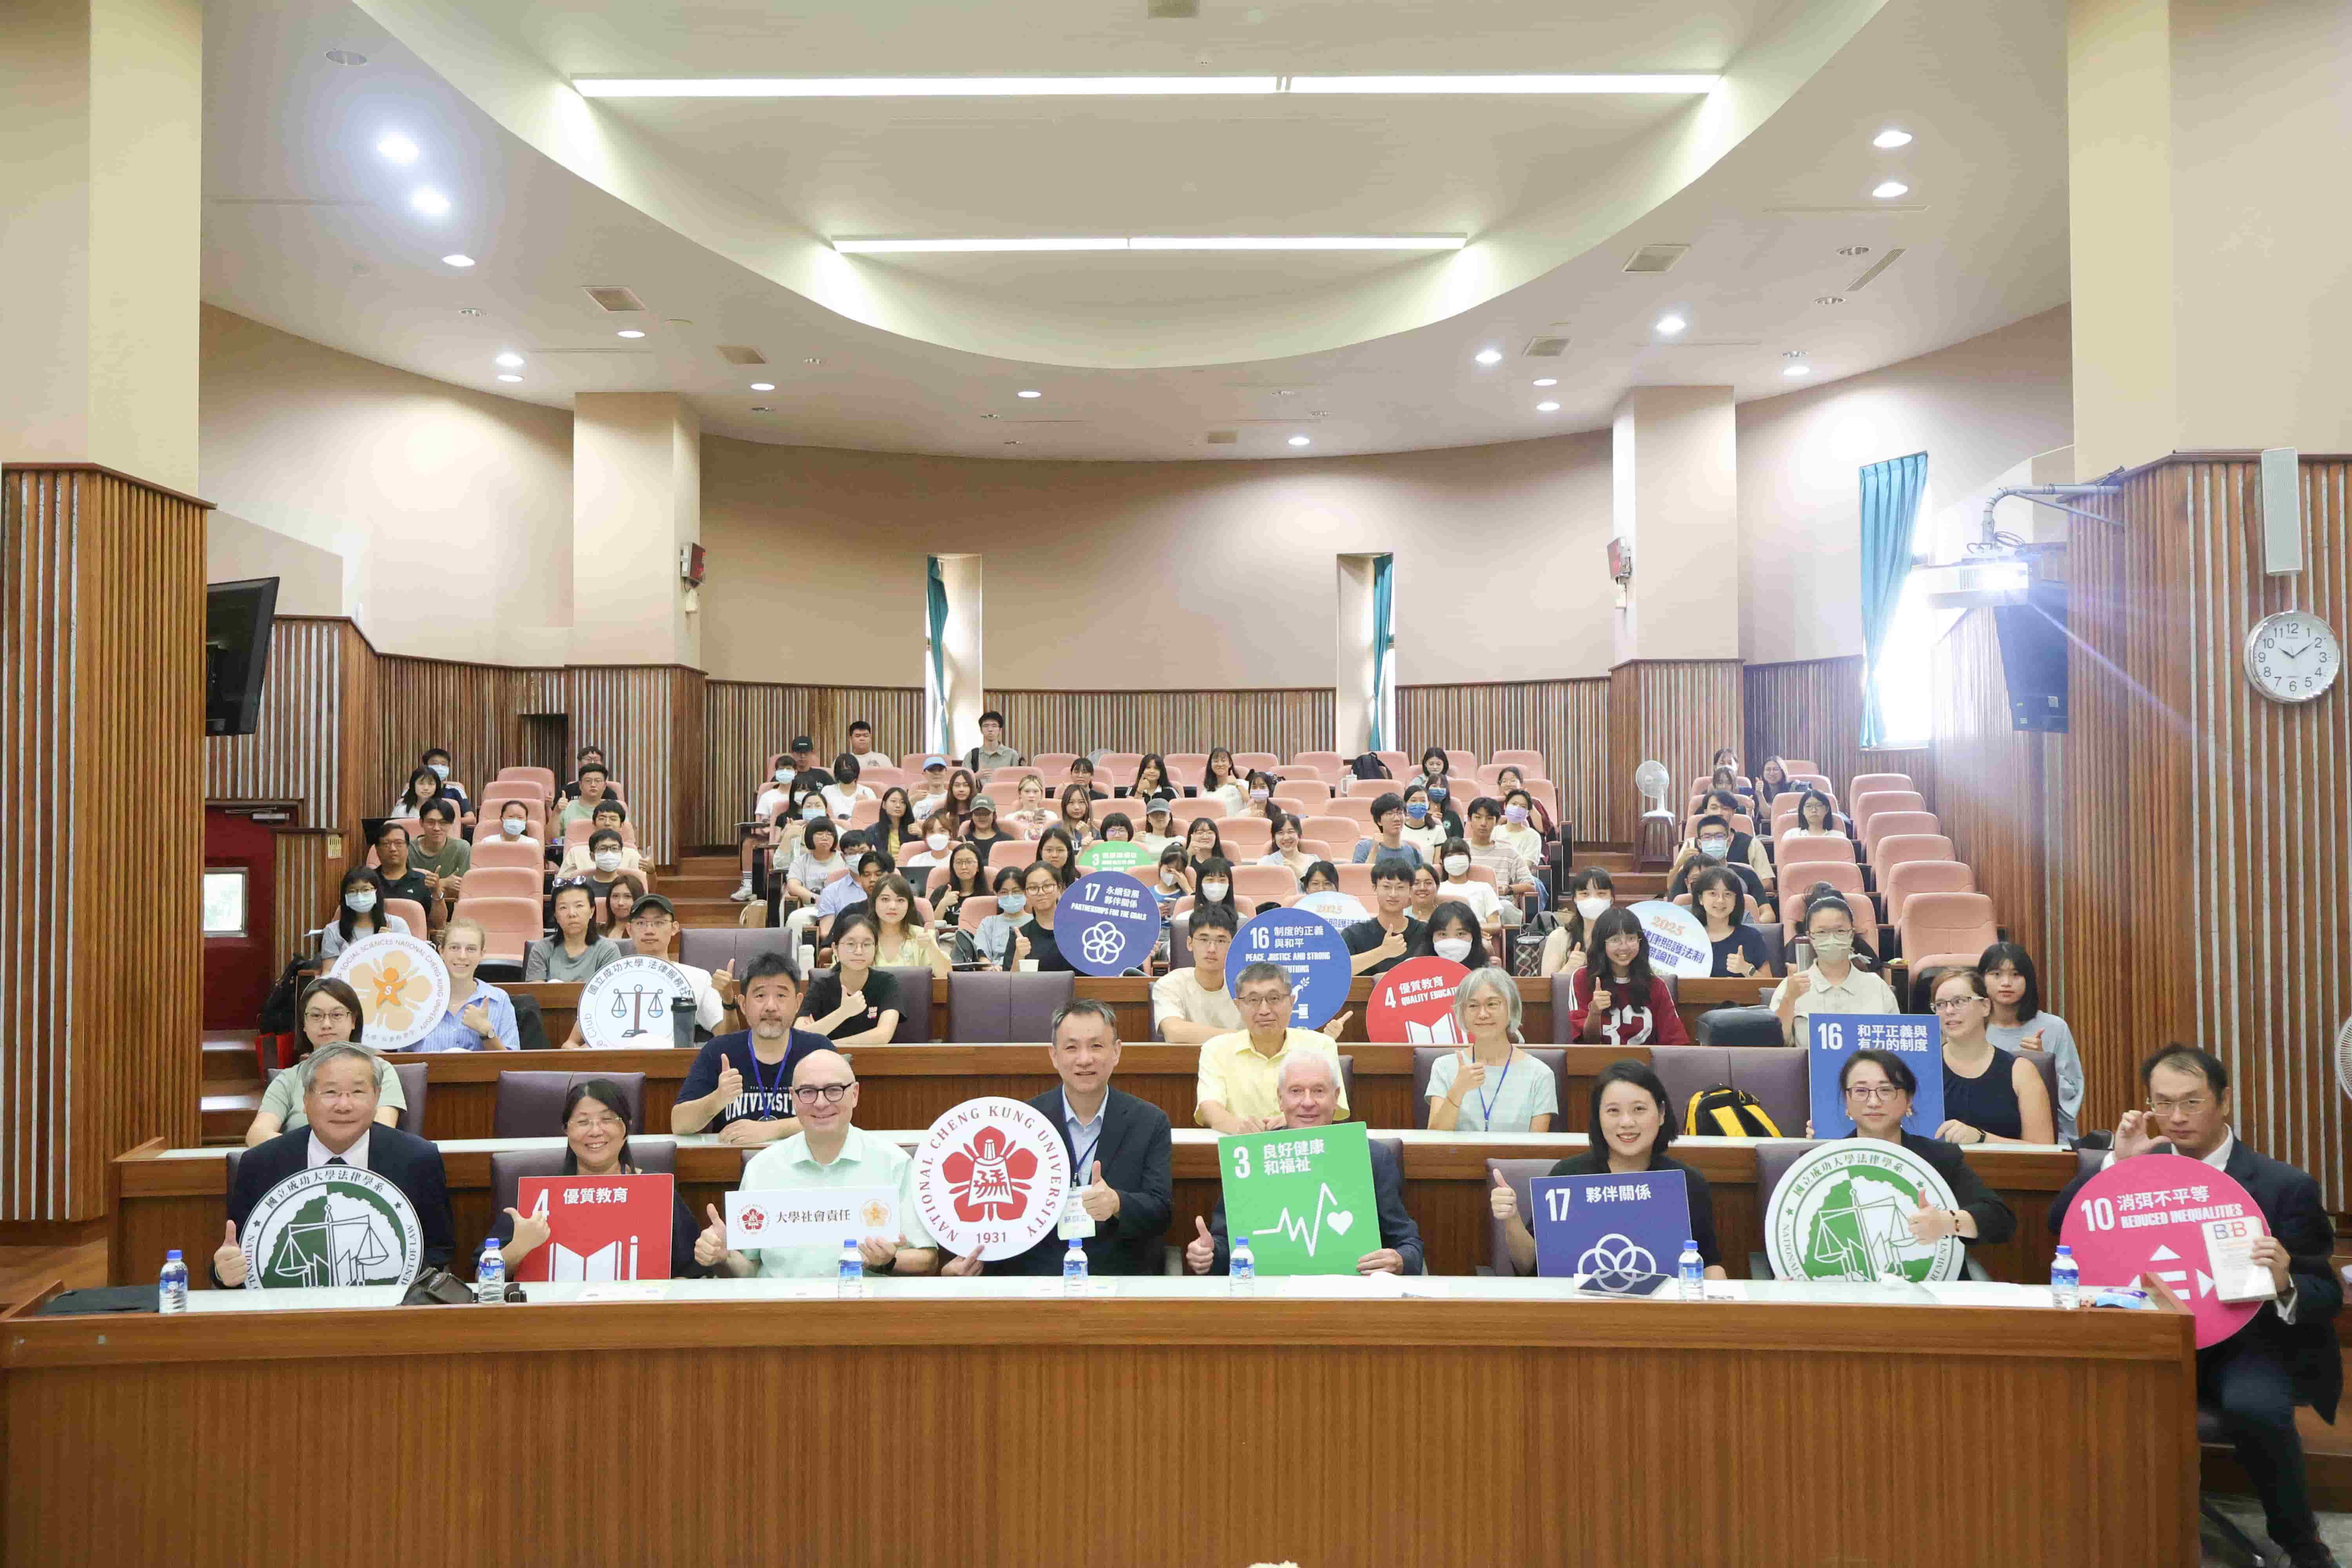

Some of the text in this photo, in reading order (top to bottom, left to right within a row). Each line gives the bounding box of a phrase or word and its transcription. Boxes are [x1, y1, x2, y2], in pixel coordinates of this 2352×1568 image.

[2274, 628, 2283, 638] 11
[2287, 622, 2299, 634] 12
[2307, 627, 2311, 637] 1
[2263, 638, 2274, 649] 10
[2314, 637, 2322, 648] 2
[2258, 652, 2266, 663] 9
[2319, 652, 2327, 663] 3
[2264, 666, 2271, 677] 8
[2314, 667, 2322, 677] 4
[2274, 677, 2282, 687] 7
[2289, 681, 2297, 692] 6
[2305, 677, 2312, 688] 5
[1092, 853, 1099, 866] 3
[1085, 883, 1101, 901] 17
[1250, 926, 1270, 949] 16
[1274, 925, 1324, 936] 制度的正義
[1274, 938, 1305, 948] 與和平
[1267, 953, 1292, 961] JUSTICE
[1293, 952, 1305, 960] AND
[1307, 951, 1331, 960] STRONG
[588, 958, 644, 995] 國立成功大學
[1399, 975, 1444, 995] 優質教育
[1385, 986, 1397, 1008] 4
[1401, 986, 1457, 1006] QUALITY EDUCAT
[1817, 1022, 1842, 1051] 16
[1857, 1024, 1928, 1038] 和平正義與
[1857, 1038, 1928, 1052] 有力的制度
[988, 1105, 1035, 1129] KUNG
[930, 1108, 979, 1149] CHENG
[1263, 1138, 1325, 1160] 良好健康
[1233, 1146, 1251, 1178] 3
[1263, 1156, 1312, 1176] 和福祉
[264, 1170, 384, 1209] 國立成功大學法律學系
[1025, 1130, 1062, 1237] UNIVERSITY
[563, 1187, 629, 1205] 優質教育
[919, 1157, 959, 1242] NATIONAL
[1585, 1183, 1652, 1204] 夥伴關係
[2116, 1185, 2210, 1211] 消弭不平等
[531, 1188, 550, 1218] 4
[1545, 1188, 1570, 1222] 17
[776, 1209, 851, 1224] 大學社會責任
[2081, 1197, 2115, 1232] 10
[2120, 1203, 2244, 1229] REDUCED INEQUALITIES
[407, 1224, 417, 1261] OF LAW
[976, 1232, 1007, 1243] 1931
